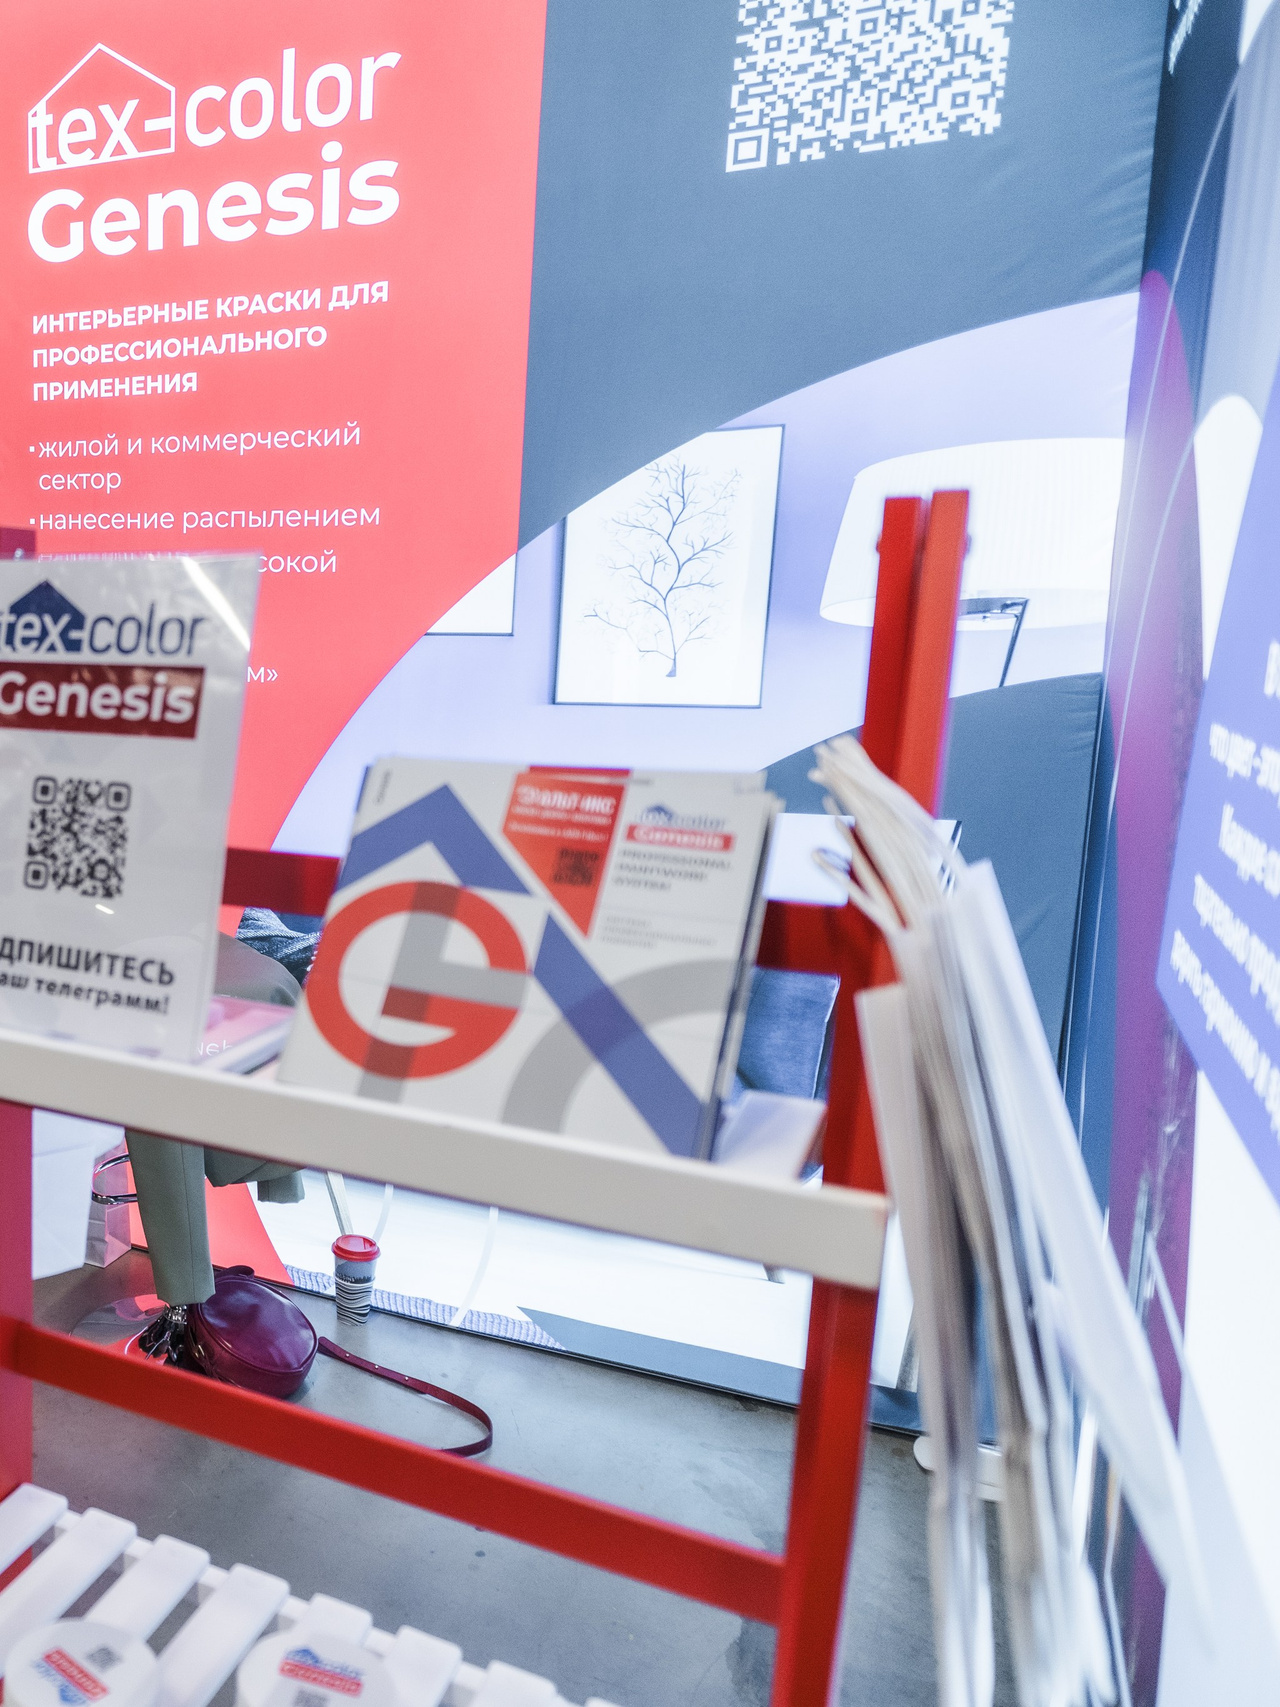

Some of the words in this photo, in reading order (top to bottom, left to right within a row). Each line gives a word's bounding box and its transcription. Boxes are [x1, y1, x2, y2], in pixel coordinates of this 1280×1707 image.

[29, 47, 402, 171] tex-color
[28, 141, 400, 263] Genesis
[32, 299, 208, 335] ИНТЕРЬЕРНЫЕ
[216, 288, 321, 319] КРАСКИ
[328, 281, 389, 311] ДЛЯ
[33, 325, 327, 368] ПРОФЕССИОНАЛЬНОГО
[33, 372, 198, 401] ПРИМЕНЕНИЯ
[38, 434, 118, 458] жилой
[128, 437, 143, 455] и
[151, 421, 361, 455] коммерческий
[39, 471, 121, 493] сектор
[39, 511, 174, 530] нанесение
[183, 507, 381, 533] распылением
[35, 976, 170, 1014] телеграмм!
